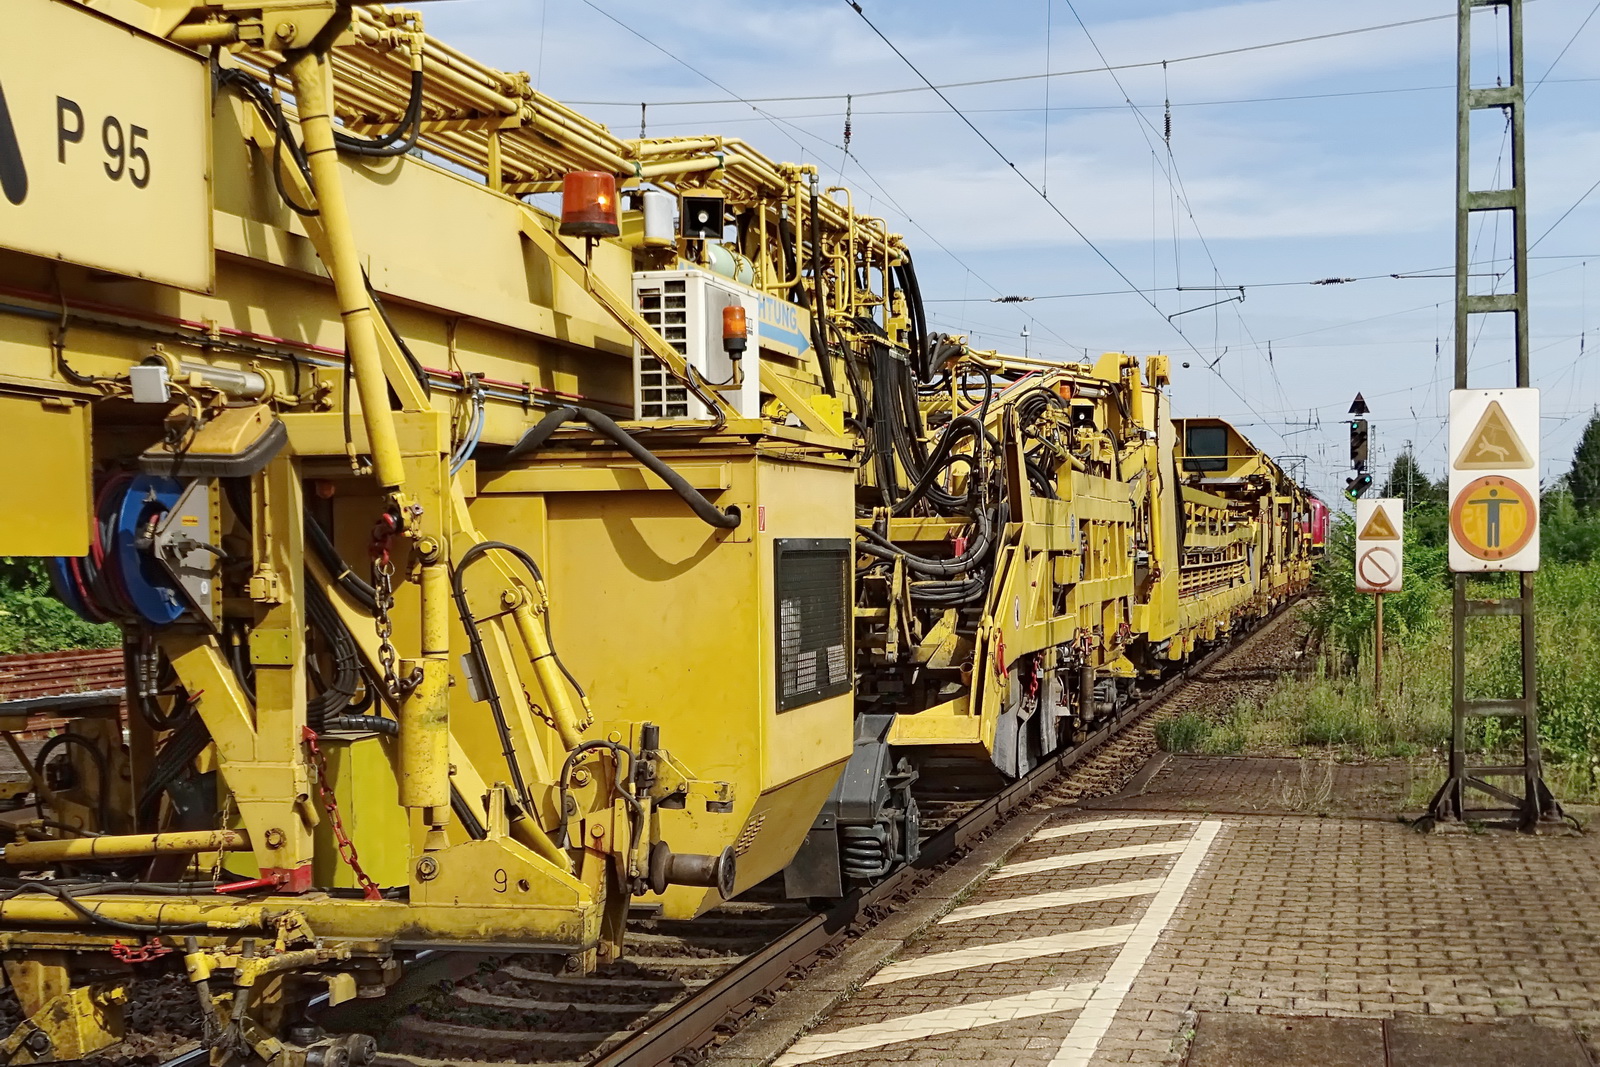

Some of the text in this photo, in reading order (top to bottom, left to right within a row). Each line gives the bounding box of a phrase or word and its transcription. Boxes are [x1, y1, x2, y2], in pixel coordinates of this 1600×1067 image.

[56, 95, 85, 165] P
[102, 115, 150, 189] 95
[758, 292, 797, 330] HTUNG
[493, 868, 507, 893] 9
